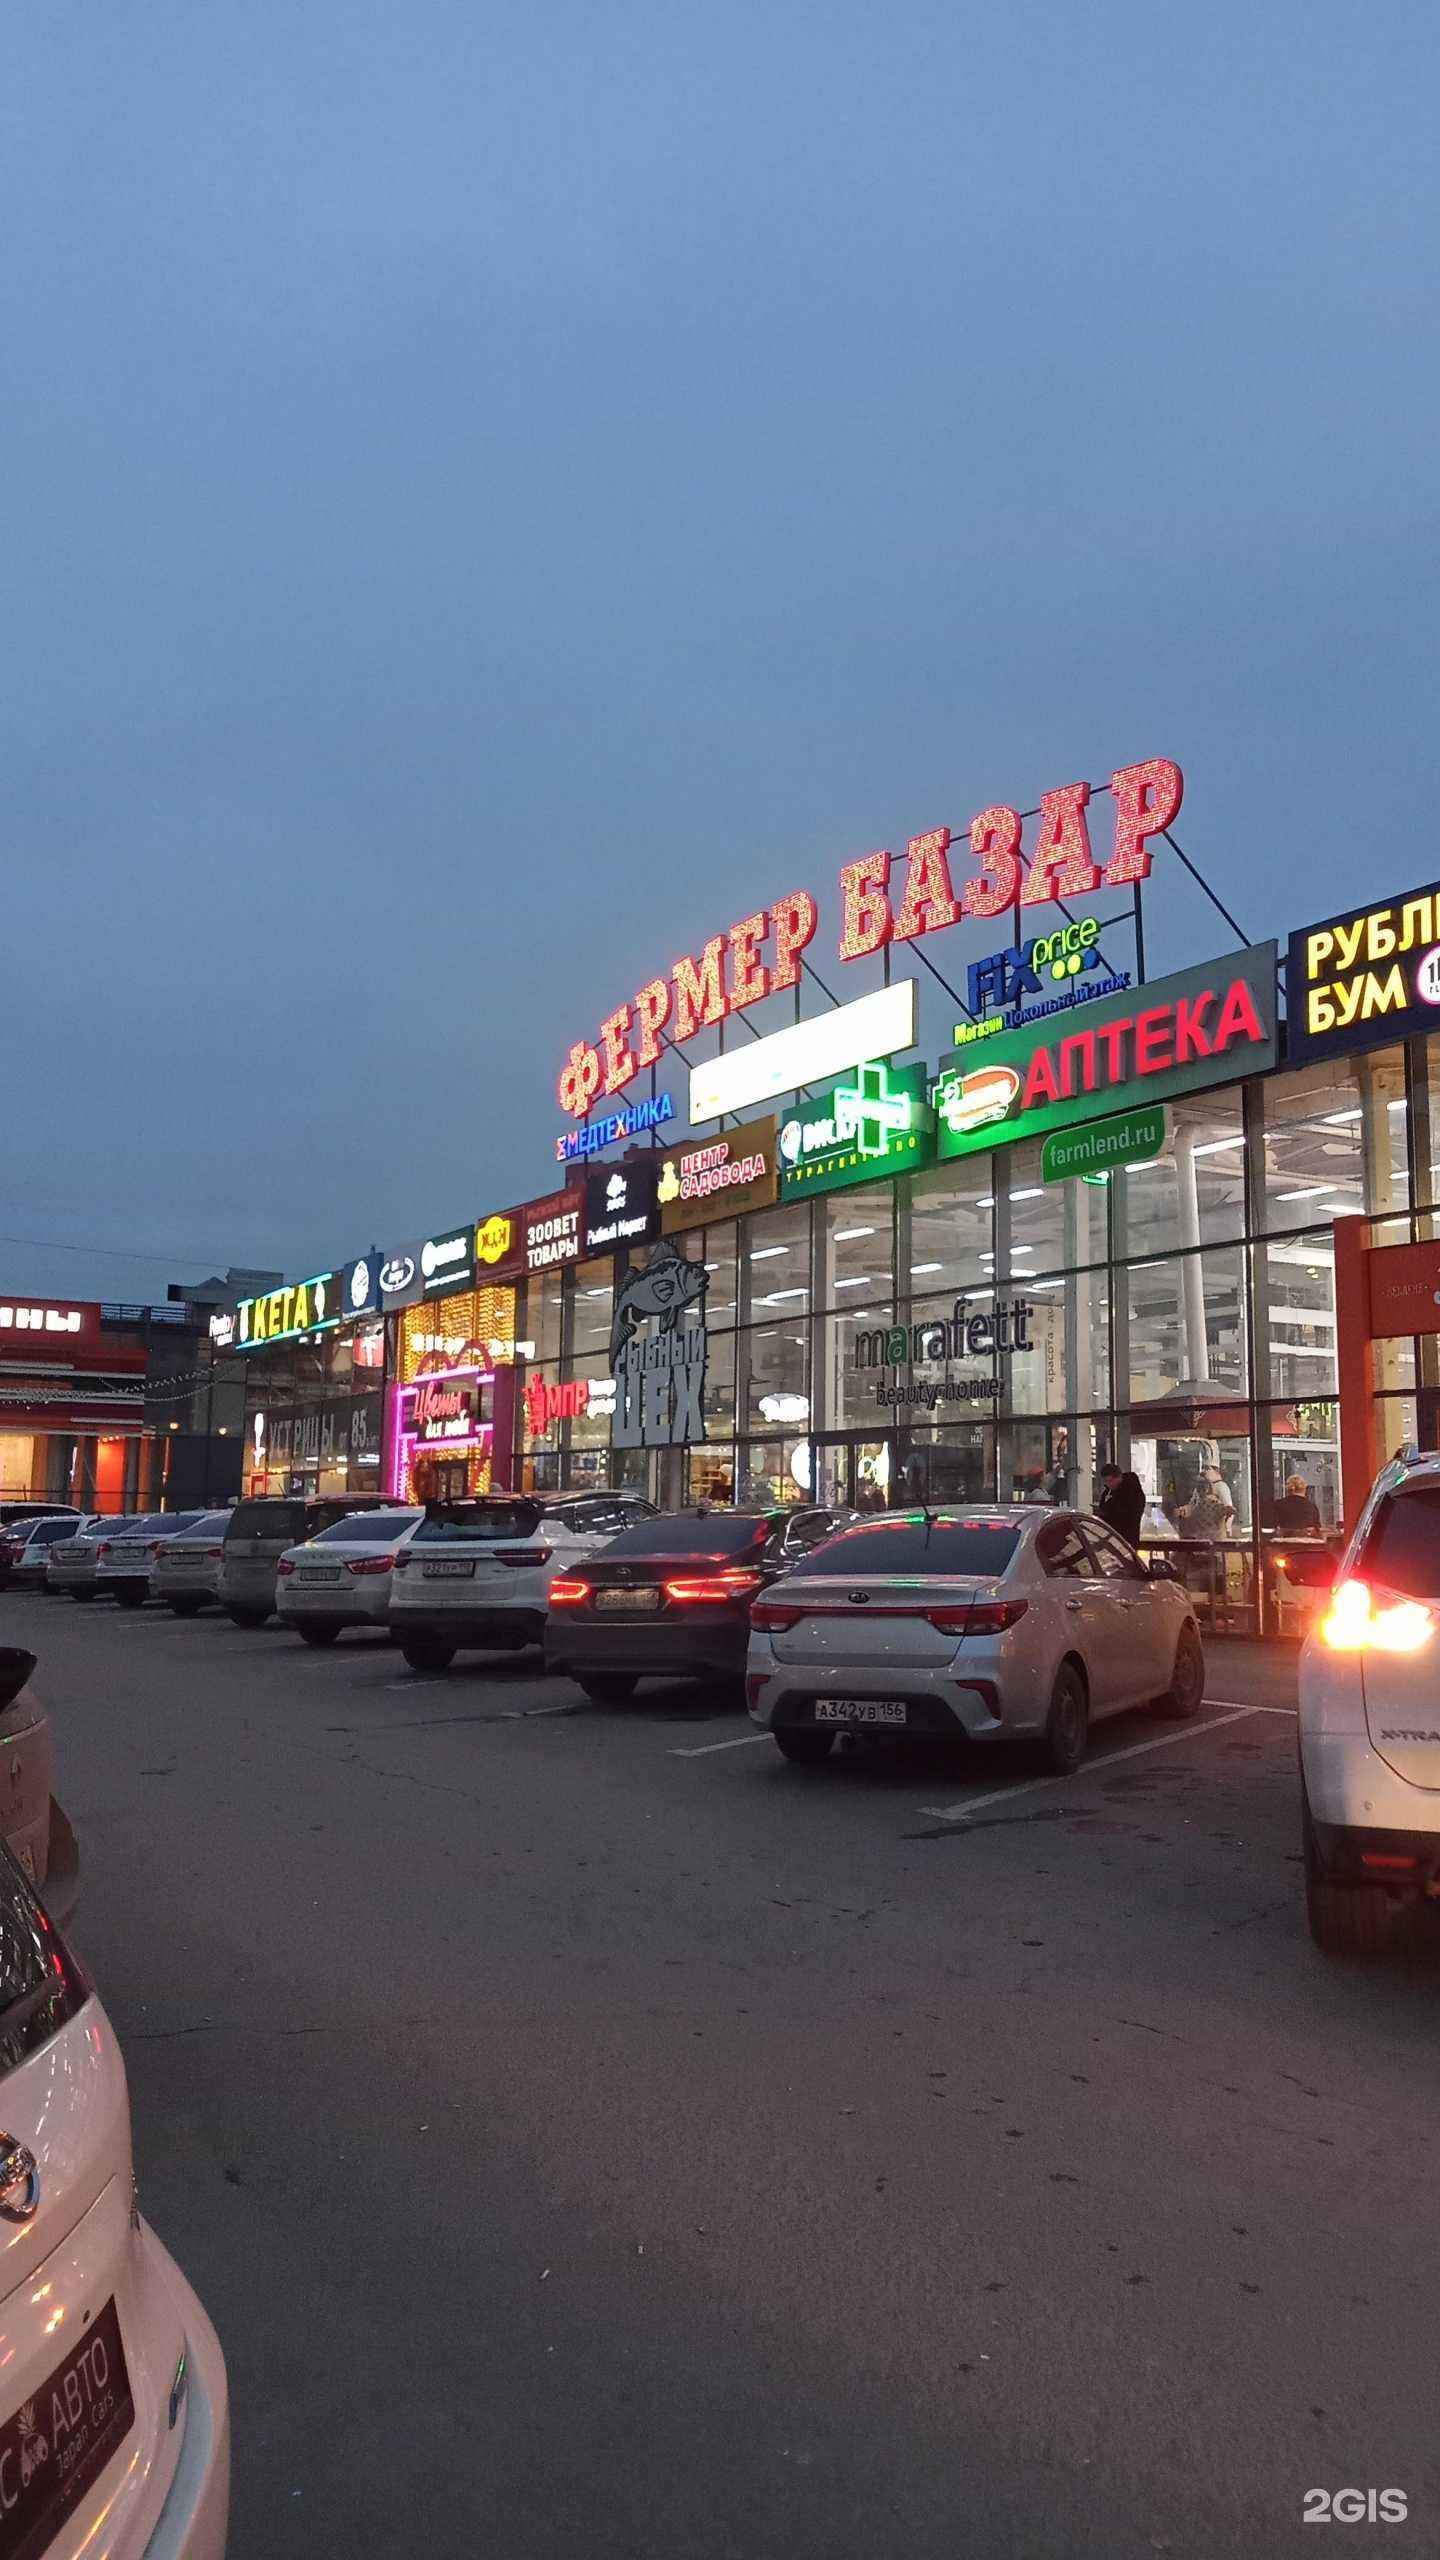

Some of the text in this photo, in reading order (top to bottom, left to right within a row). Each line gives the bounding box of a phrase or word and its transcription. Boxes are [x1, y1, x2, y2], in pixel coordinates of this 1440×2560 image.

[557, 758, 1184, 1119] ФЕРМЕР БАЗАР
[1306, 892, 1440, 980] РУБЛ
[1308, 962, 1408, 1035] БУМ
[953, 1015, 1004, 1046] Магазин
[1020, 978, 1265, 1109] АПТЕКА
[567, 1092, 675, 1157] МЕДТЕХНИКА
[1049, 1124, 1156, 1167] farmlend.ru
[680, 1142, 729, 1178] ЦЕНТР
[680, 1153, 766, 1199] САДОВОДА
[786, 1135, 917, 1184] ТУРАГЕНТВО
[527, 1211, 580, 1246] ЗООВЕТ
[527, 1235, 579, 1269] ТОВАРЫ
[613, 1327, 706, 1376] РЫБНЫЙ
[854, 1296, 1034, 1369] marafett
[611, 1360, 708, 1448] ЦЕХ
[876, 1381, 937, 1410] beauty
[51, 2336, 109, 2448] АВТО
